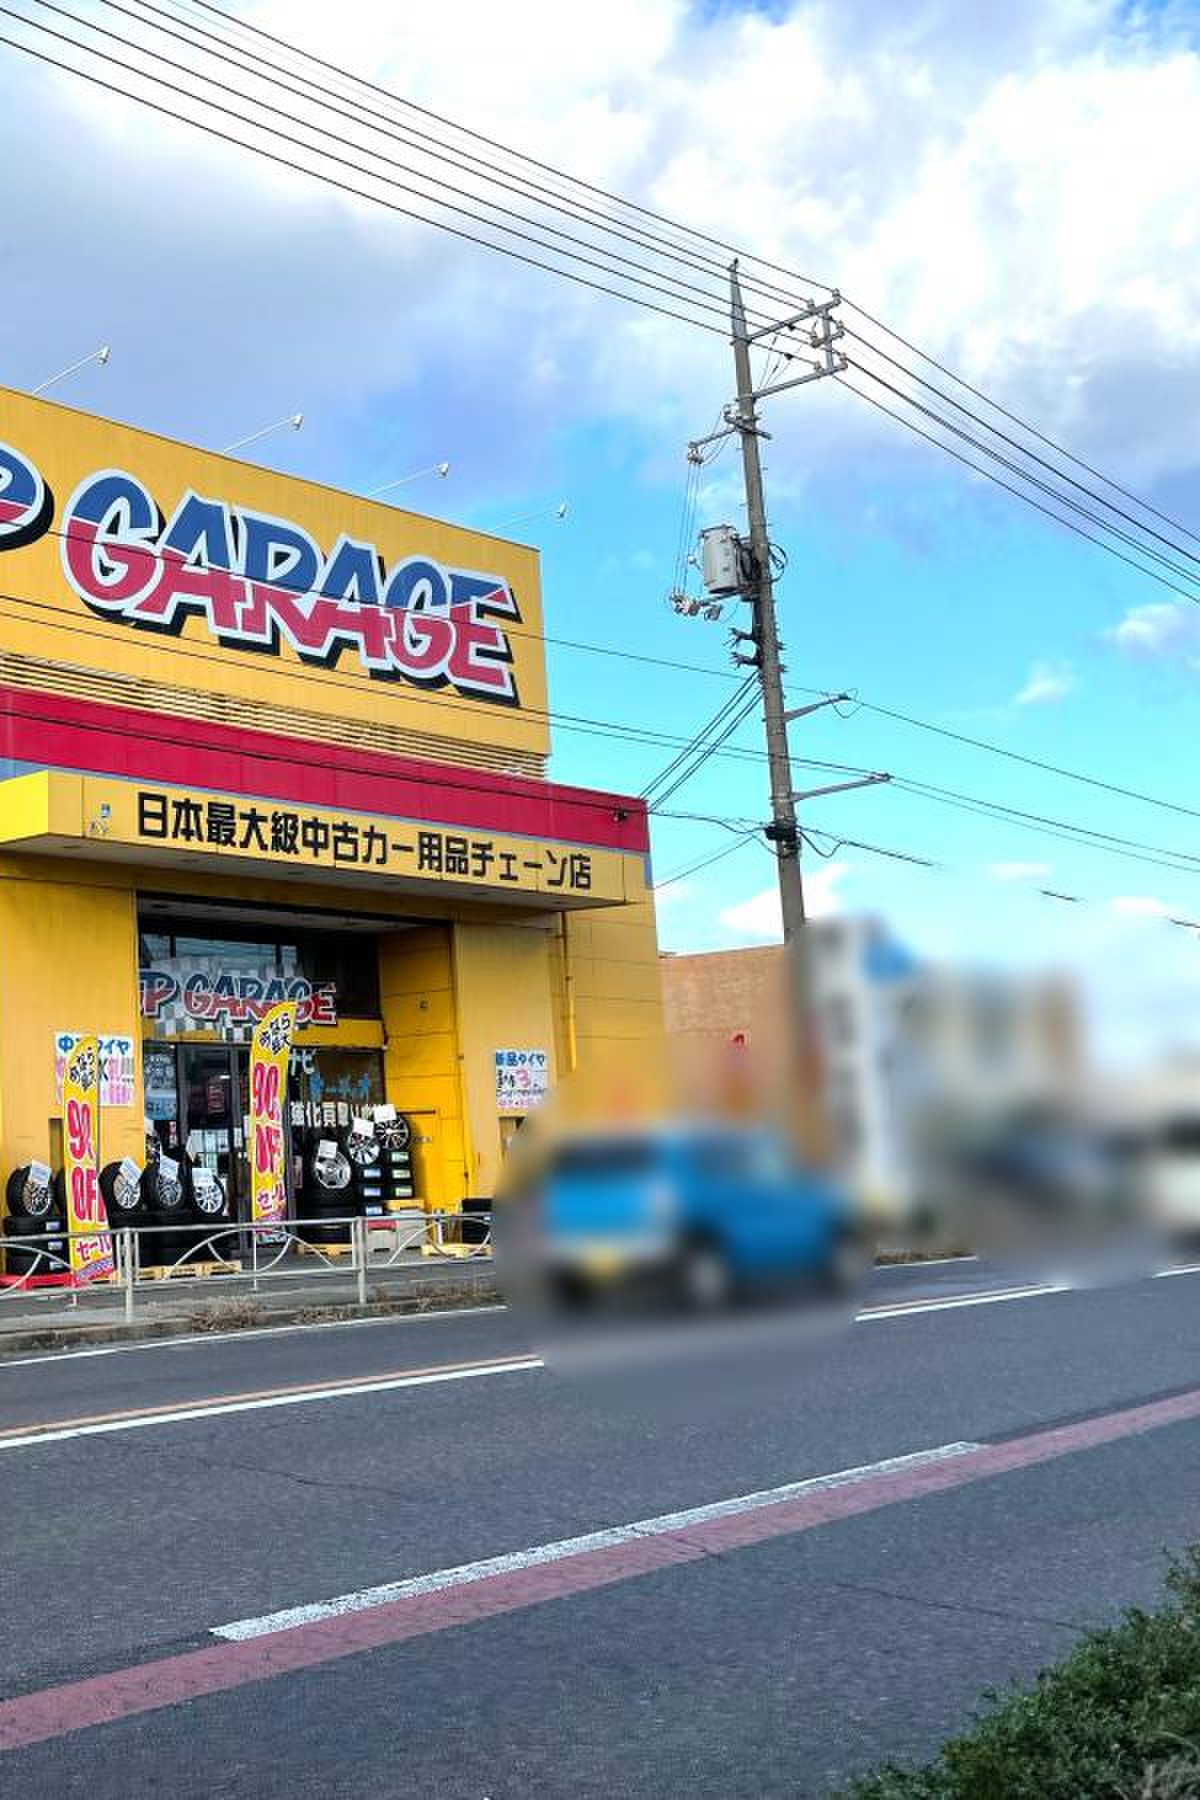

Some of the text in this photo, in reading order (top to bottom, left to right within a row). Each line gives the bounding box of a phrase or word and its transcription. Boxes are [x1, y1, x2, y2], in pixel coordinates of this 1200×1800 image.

[60, 468, 522, 708] GARAGE
[137, 791, 592, 890] 日本最大級中古カー用品チェーン店
